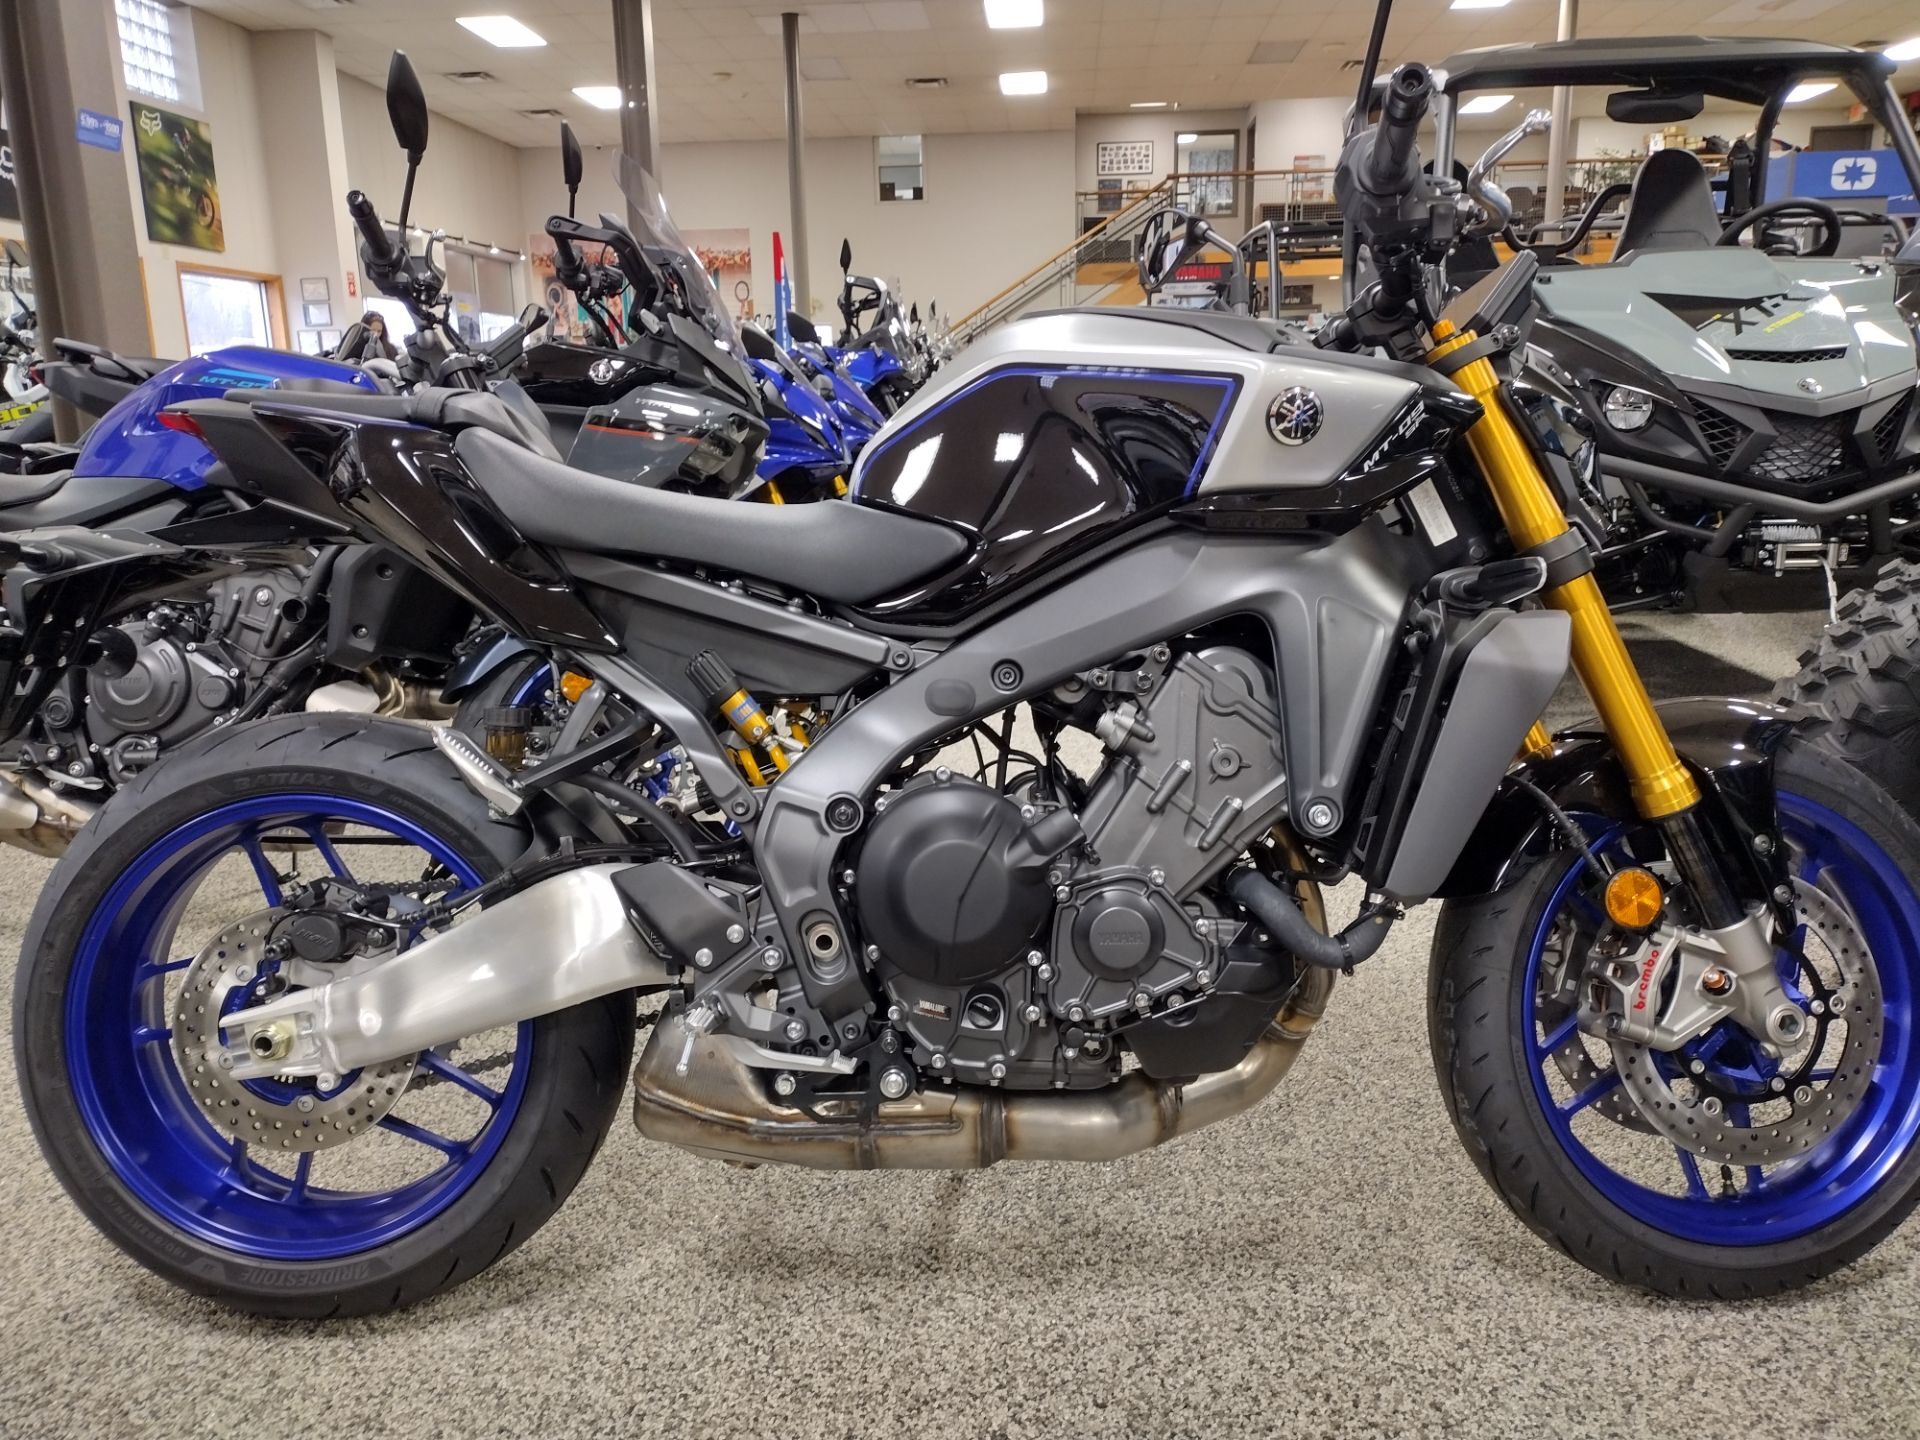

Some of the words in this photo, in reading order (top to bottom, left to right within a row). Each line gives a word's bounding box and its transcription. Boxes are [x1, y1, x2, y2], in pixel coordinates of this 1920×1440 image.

[1363, 400, 1425, 472] MT-09
[1633, 950, 1659, 1010] brembo
[240, 1263, 371, 1289] BRIDGESTONE
